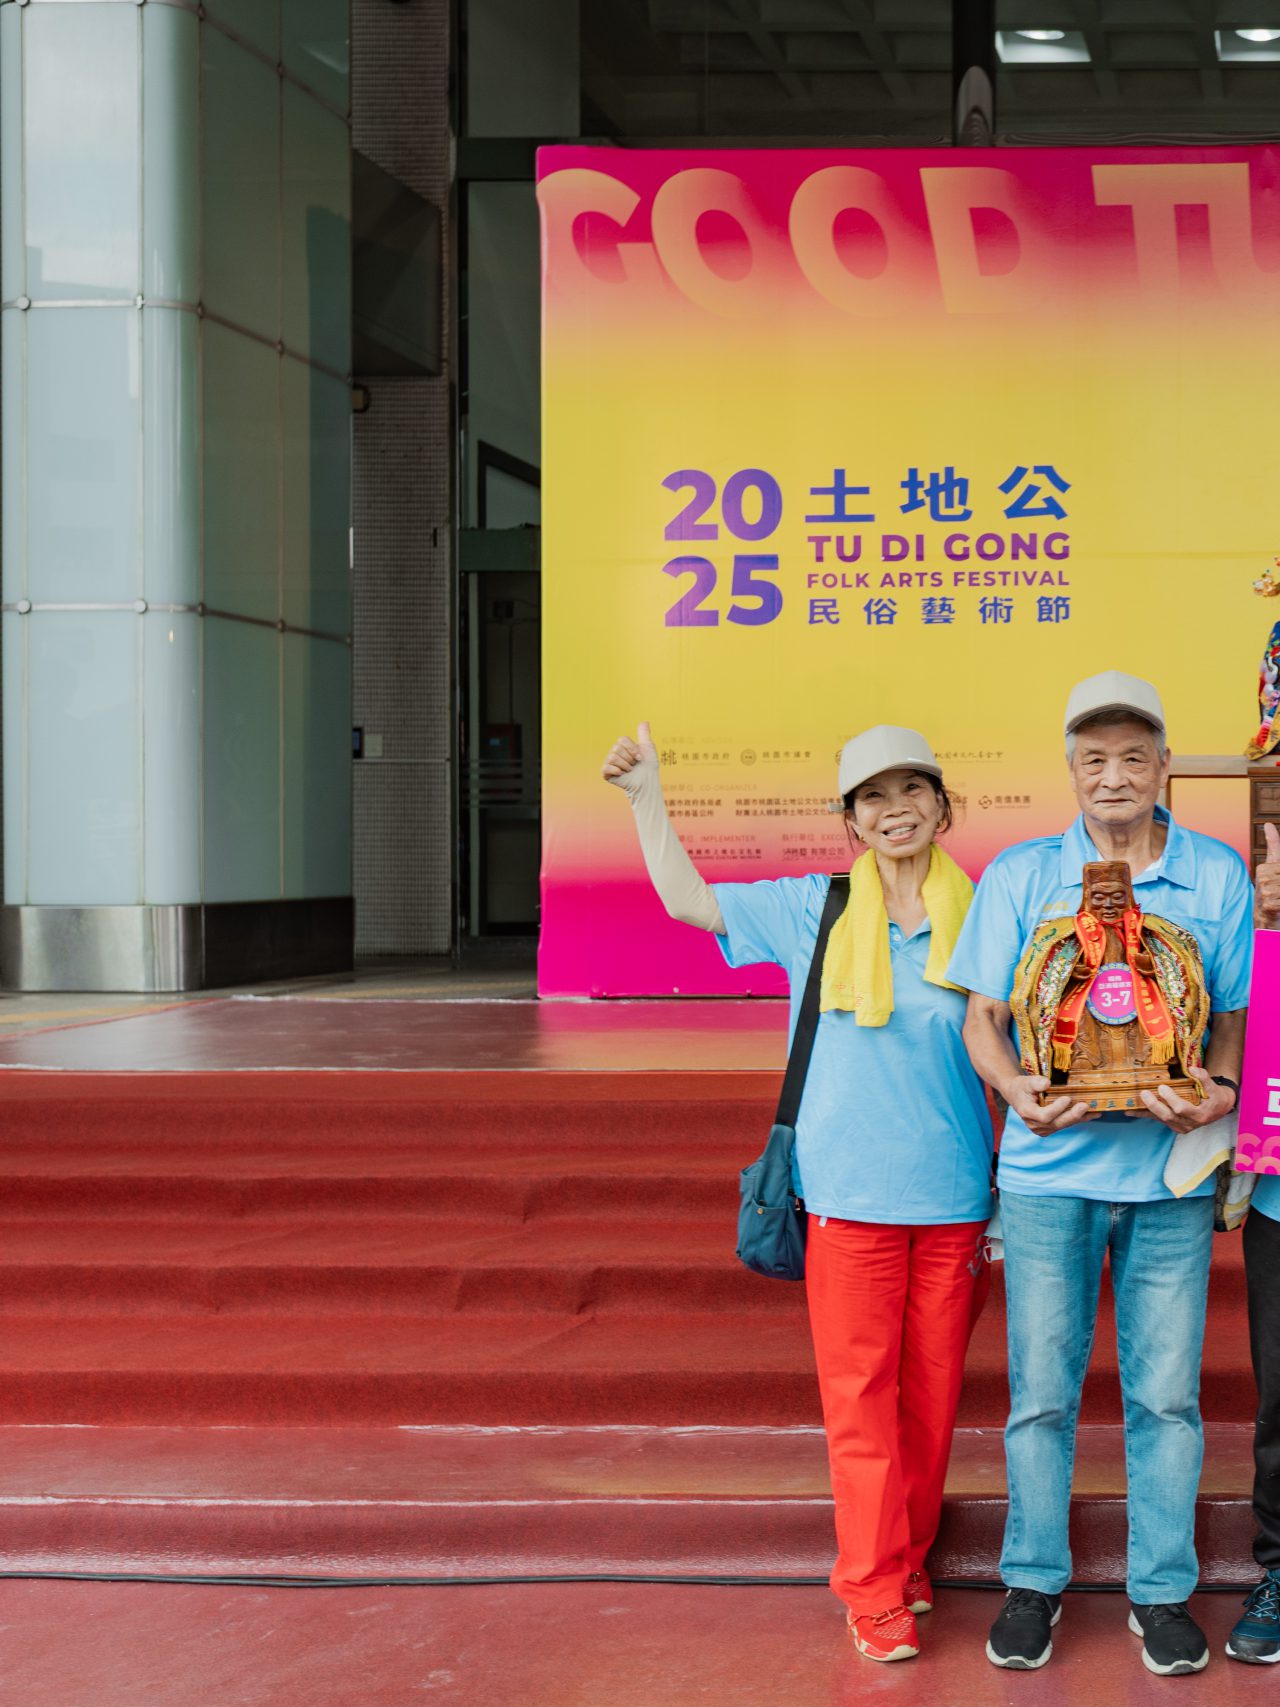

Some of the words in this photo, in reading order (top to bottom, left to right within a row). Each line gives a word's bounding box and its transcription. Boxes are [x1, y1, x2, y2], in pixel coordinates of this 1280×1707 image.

[536, 165, 1047, 317] GOOD
[804, 465, 1072, 524] 土地公
[807, 535, 862, 563] TU
[881, 534, 926, 562] DI
[942, 532, 1071, 561] GONG
[806, 572, 870, 589] FOLK
[879, 571, 944, 589] ARTS
[953, 570, 1071, 588] FESTIVAL
[806, 595, 1072, 627] 民俗藝術節
[667, 809, 714, 818] 園市各區公所
[1100, 990, 1132, 1008] 3-7
